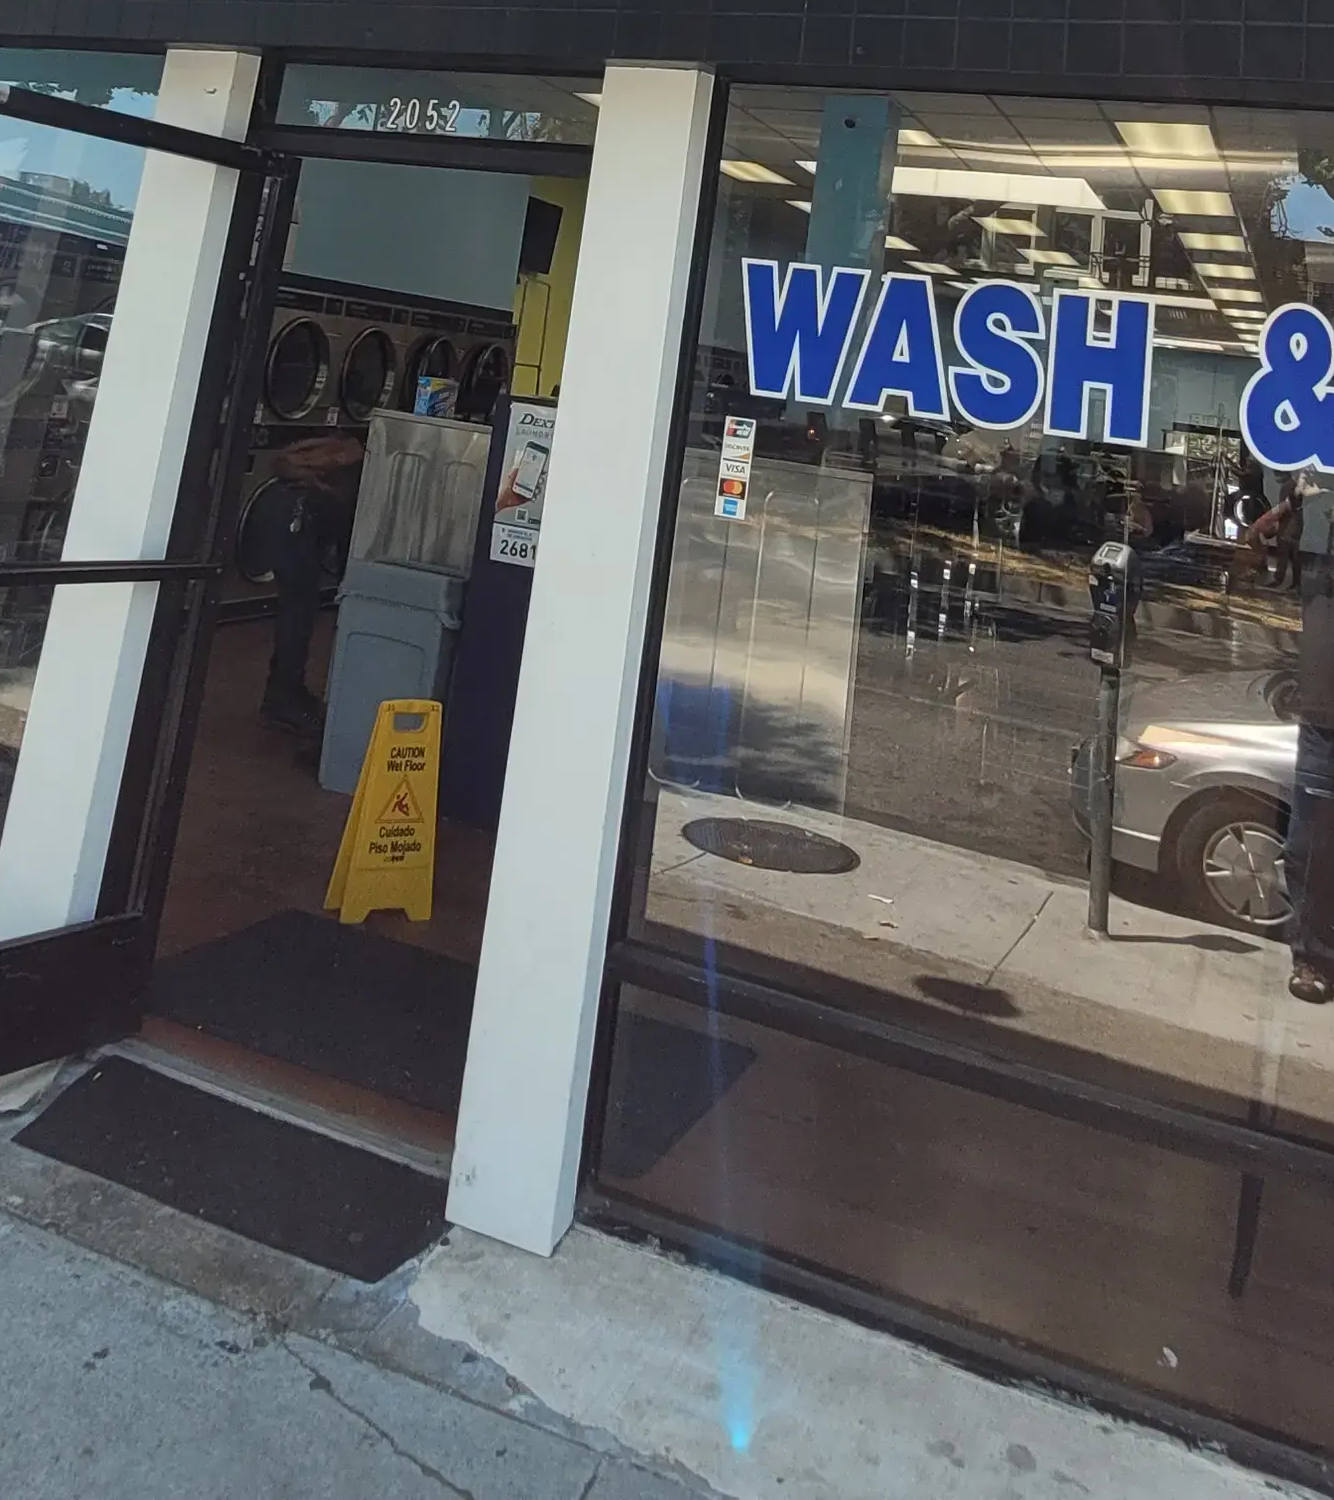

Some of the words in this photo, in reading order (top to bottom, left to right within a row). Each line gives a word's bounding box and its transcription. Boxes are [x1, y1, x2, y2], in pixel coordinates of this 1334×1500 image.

[386, 97, 461, 132] 2052
[740, 256, 1155, 449] WASH
[725, 462, 747, 475] VISA
[499, 539, 537, 561] 2681
[390, 746, 427, 760] CAUTION
[387, 760, 403, 773] Wet
[404, 759, 427, 773] Floor
[379, 825, 415, 839] Cuidado
[369, 841, 388, 855] Piso
[389, 840, 422, 857] Mojado
